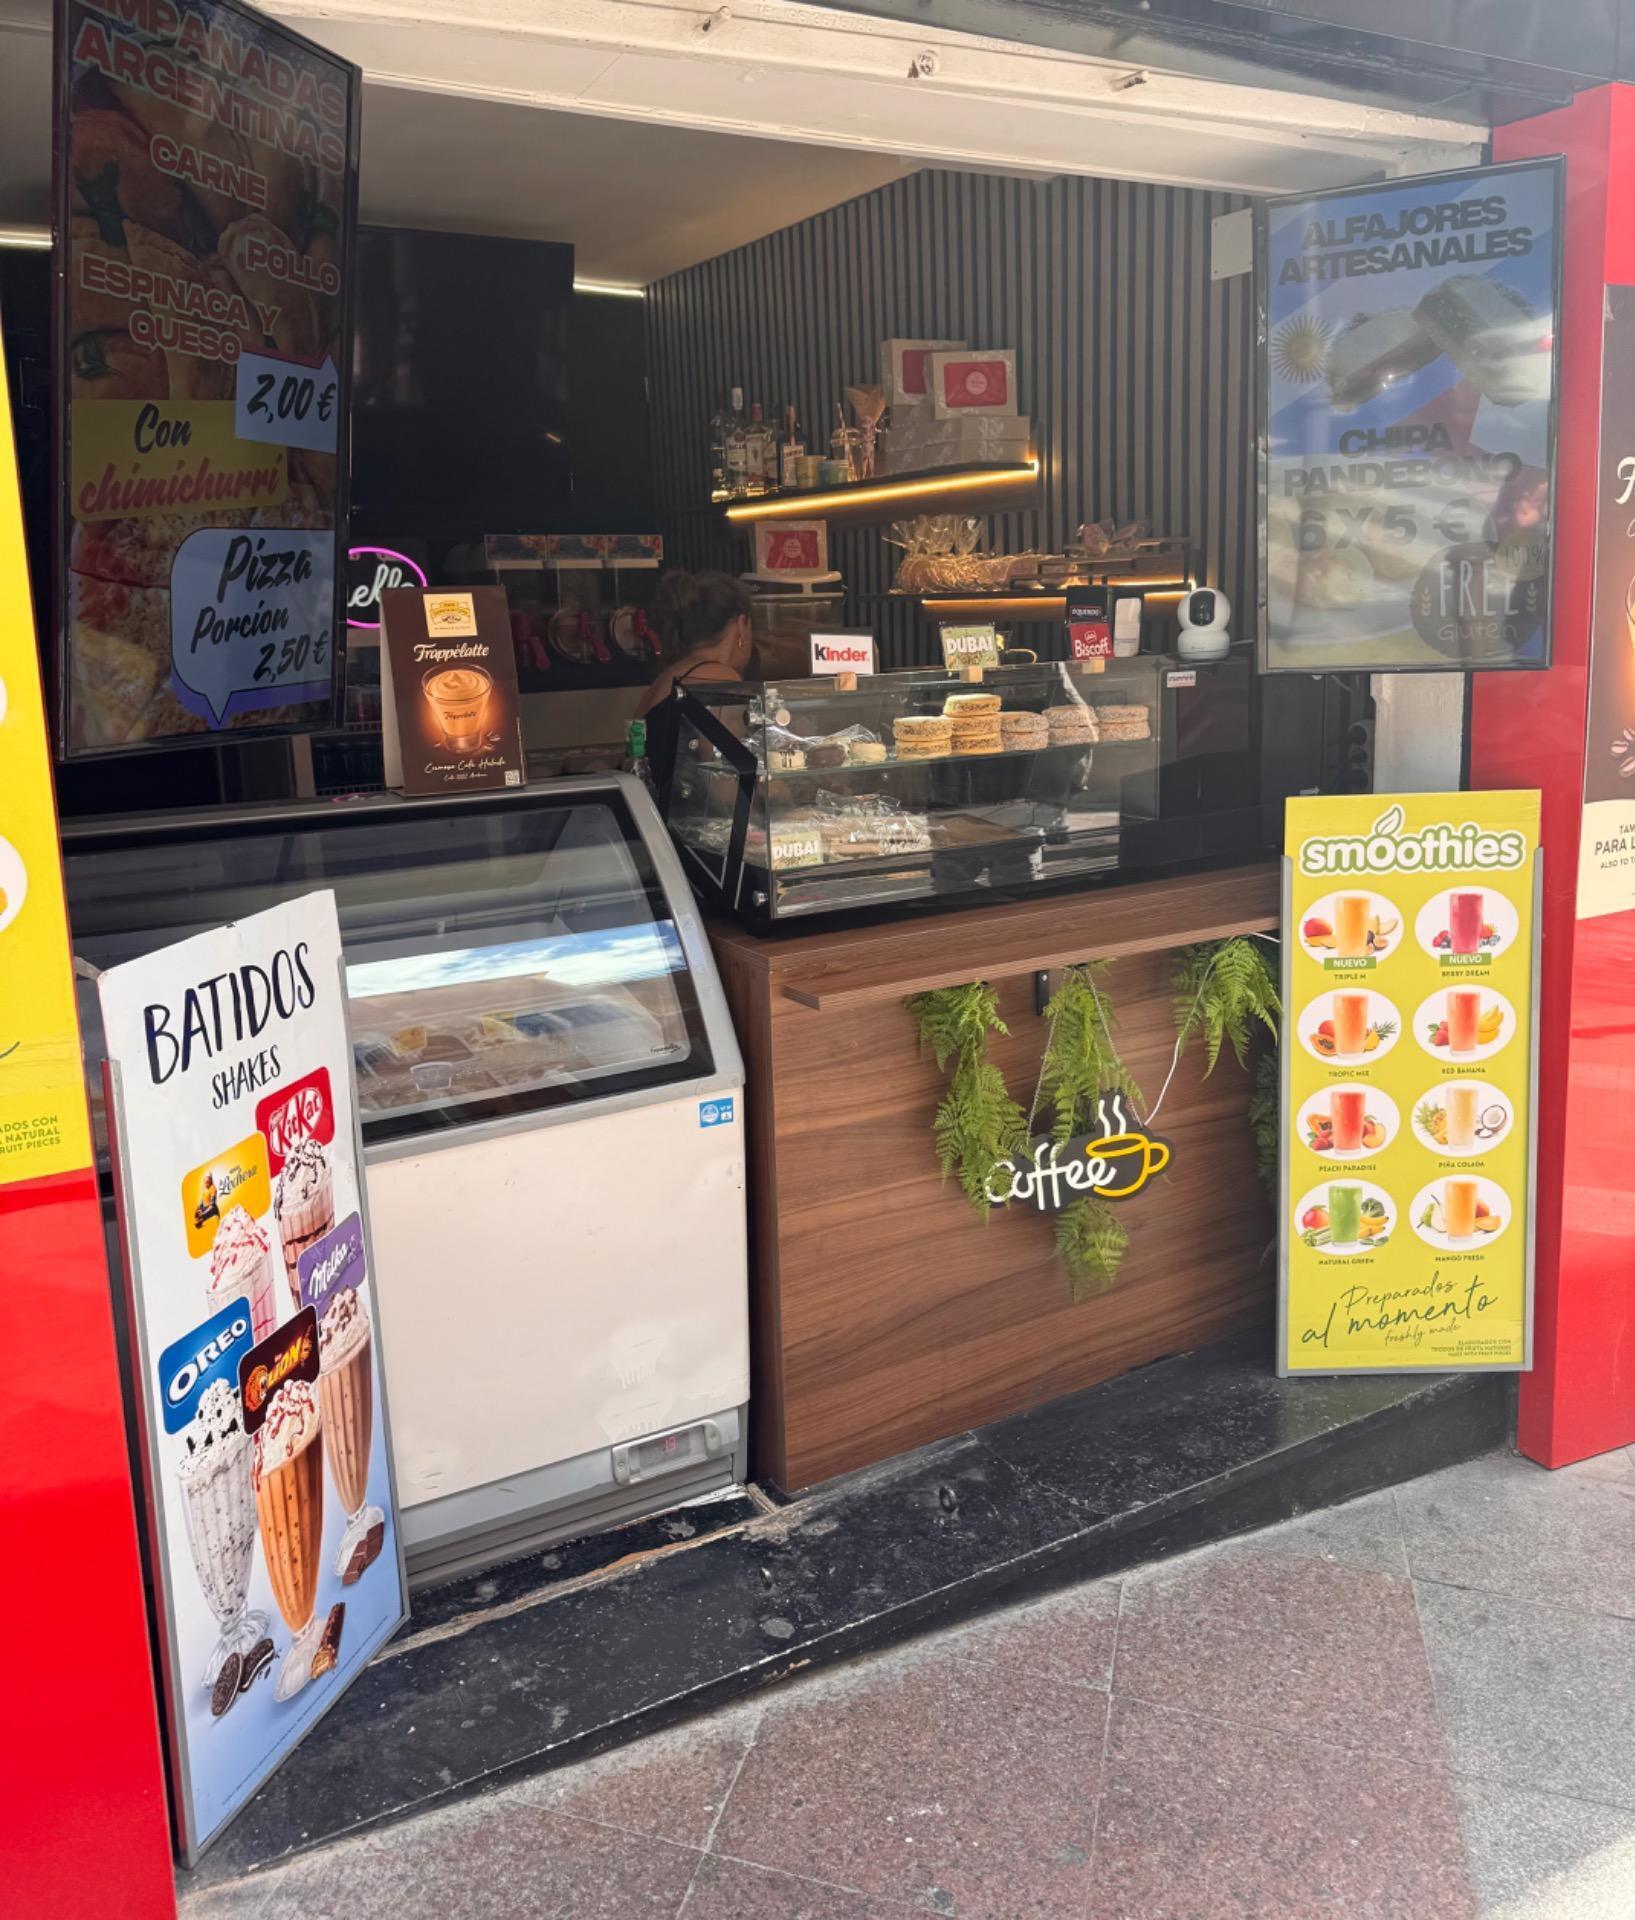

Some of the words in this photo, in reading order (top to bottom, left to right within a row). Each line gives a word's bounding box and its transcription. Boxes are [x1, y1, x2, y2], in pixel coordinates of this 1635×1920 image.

[74, 18, 346, 174] ARGENTINAS
[150, 134, 267, 209] CARNE
[1302, 195, 1507, 249] ALFAJORES
[245, 235, 340, 295] POLLO
[1278, 227, 1533, 286] ARTESANALES
[80, 252, 250, 330] ESPINACA
[256, 303, 282, 335] Y
[129, 310, 242, 364] QUESO
[134, 403, 192, 453] Con
[1339, 422, 1452, 459] CHIPA
[77, 453, 283, 515] chimichurri
[1284, 452, 1522, 497] PANDEBONO
[1298, 510, 1326, 552] 6
[1384, 504, 1417, 546] 5
[1433, 499, 1470, 542] €
[217, 535, 312, 603] Pizza
[1439, 559, 1519, 617] FREE
[946, 635, 993, 655] DUBAI
[771, 839, 818, 860] DUBAI
[1594, 837, 1628, 856] PARA
[1333, 958, 1368, 968] NUEVO
[1449, 953, 1483, 965] NUEVO
[144, 942, 316, 1084] BATIDOS
[211, 1045, 281, 1110] SHAKES
[5, 1126, 61, 1144] NATURAL
[26, 1136, 61, 1150] PIECES
[31, 1114, 58, 1128] CON
[275, 1089, 320, 1152] KitKat
[308, 1243, 348, 1300] Milka
[1340, 1270, 1458, 1316] Preparados
[1301, 1302, 1338, 1349] al
[1347, 1274, 1499, 1335] momento
[167, 1317, 249, 1404] OREO
